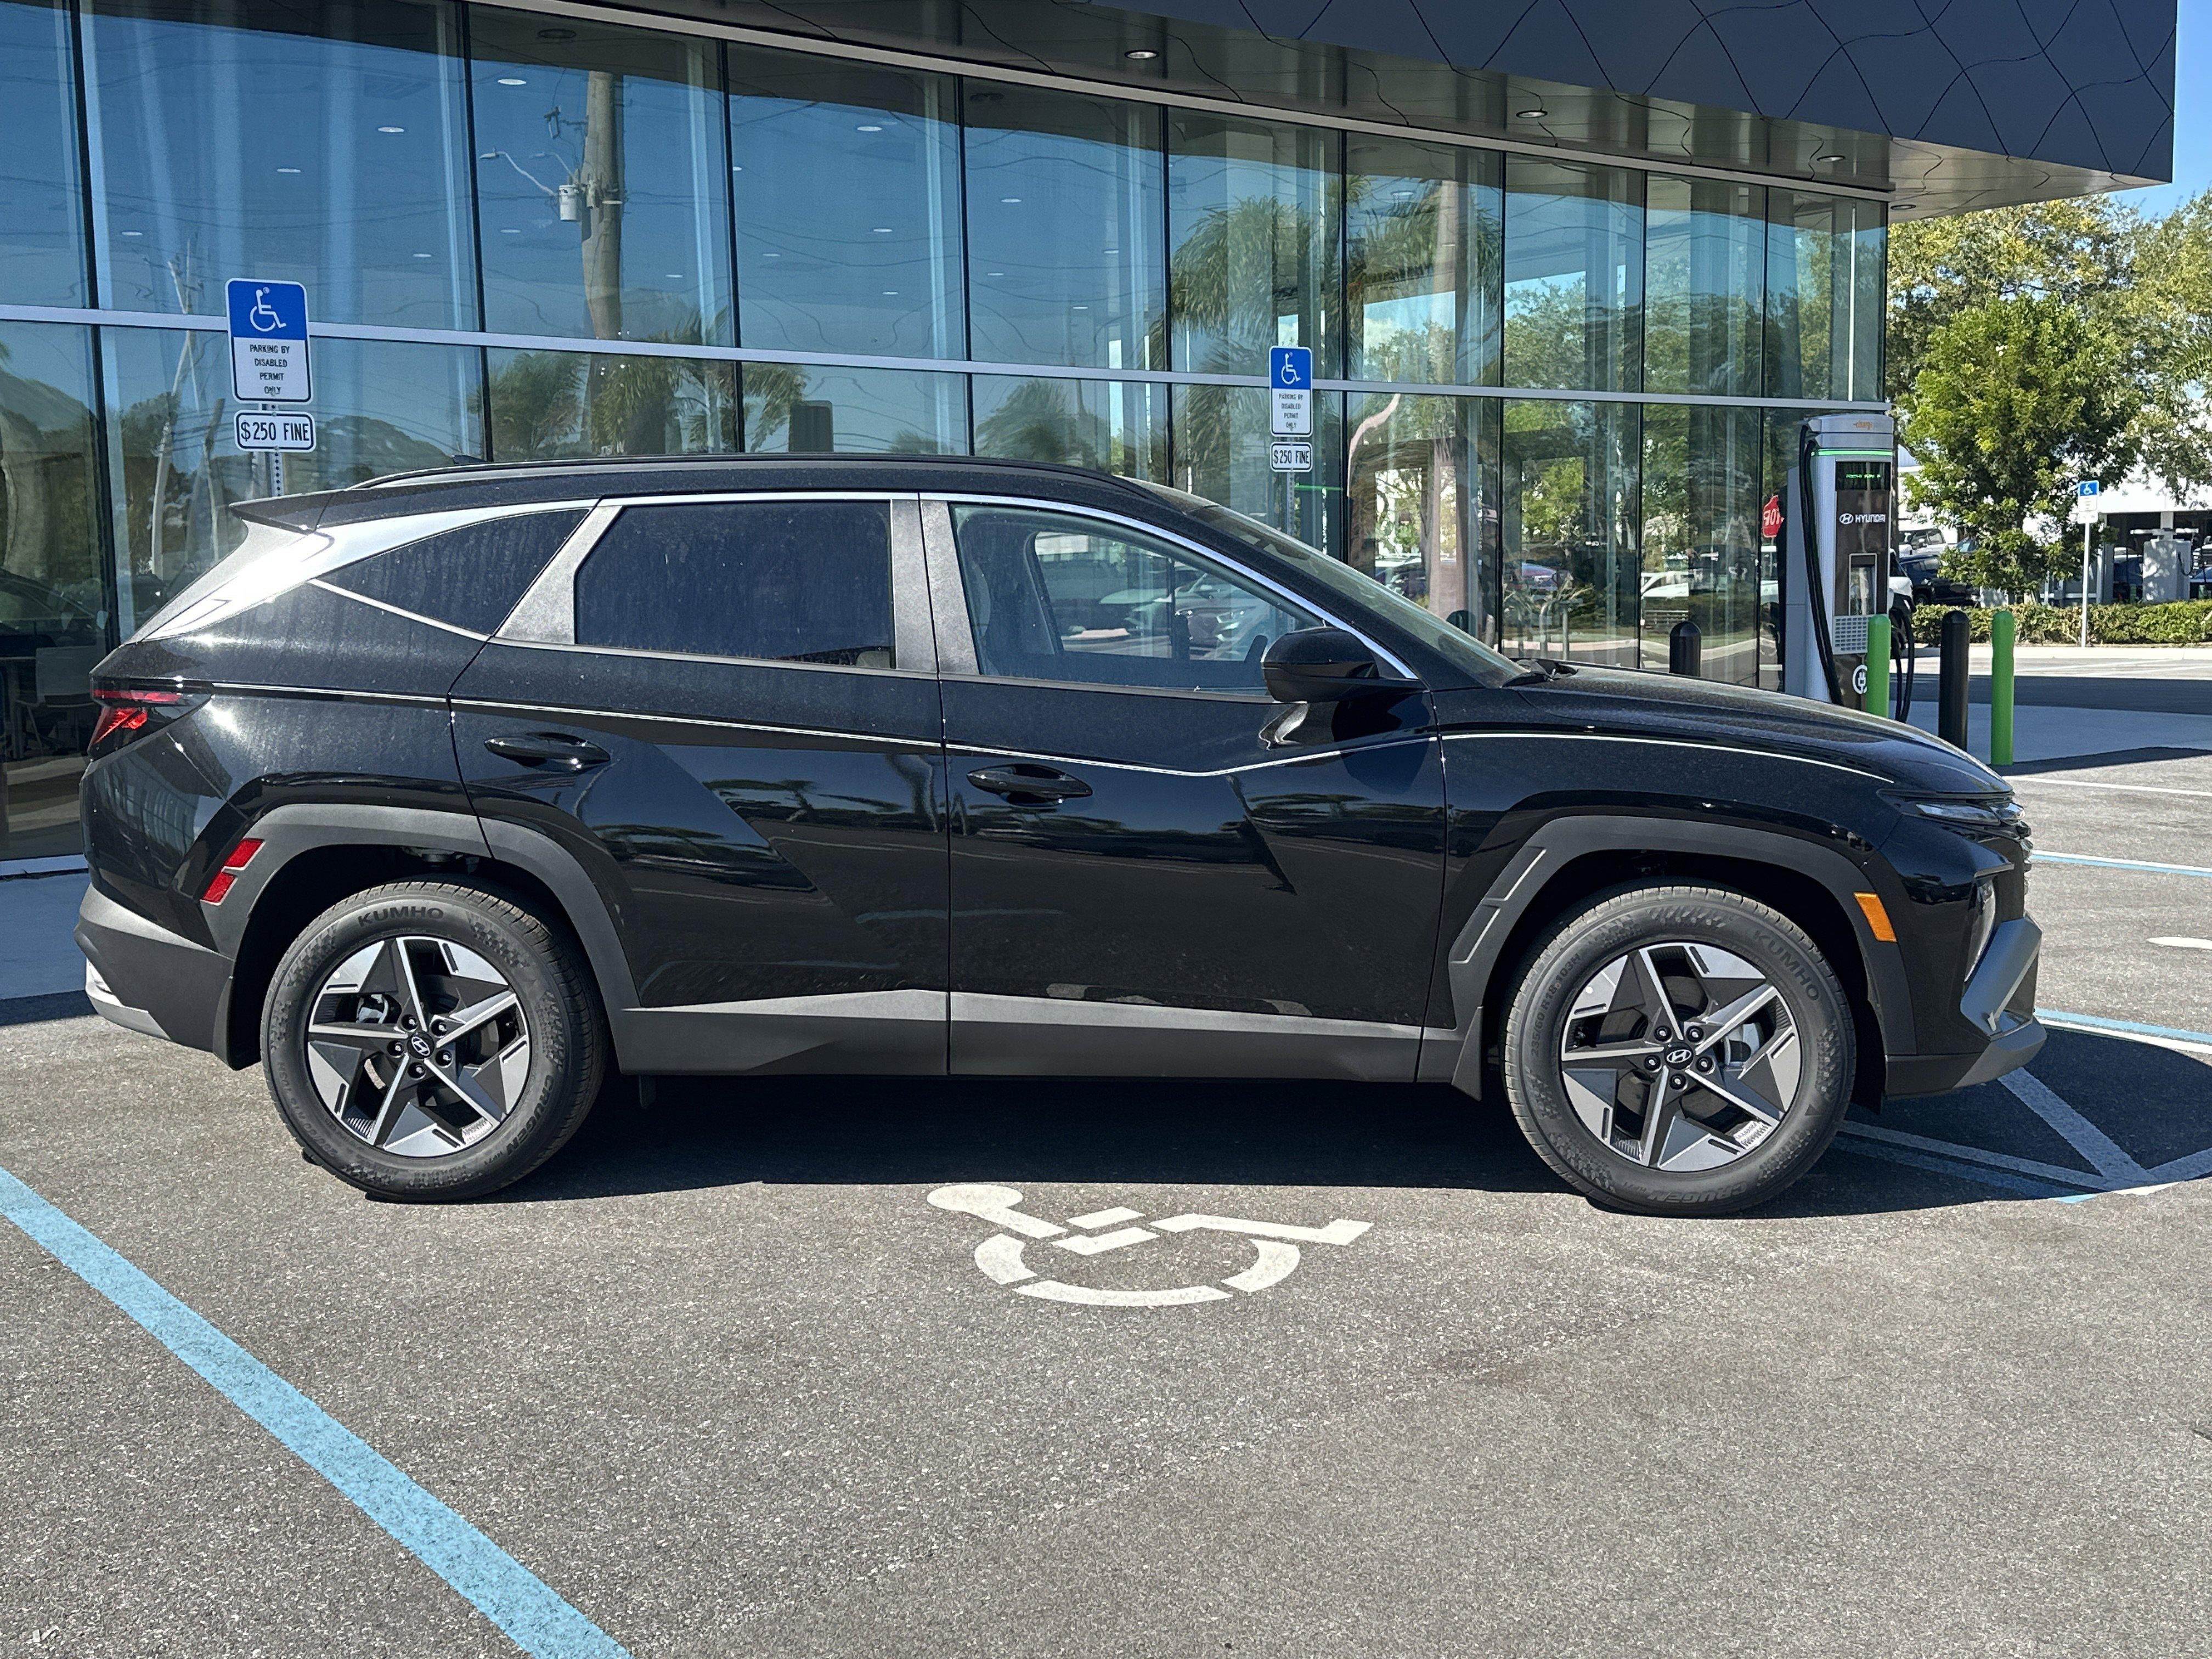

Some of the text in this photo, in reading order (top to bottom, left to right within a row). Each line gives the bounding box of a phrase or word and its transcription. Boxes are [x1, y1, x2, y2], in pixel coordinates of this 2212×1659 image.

[250, 344, 290, 354] PARKING BY
[254, 358, 287, 368] DISABLED
[259, 372, 284, 381] PERMIT
[264, 386, 281, 395] ONLY
[240, 420, 309, 442] $250 FINE
[1273, 450, 1310, 465] $250 FINE
[1855, 514, 1886, 523] HYUNDAI
[358, 906, 444, 927] KUMHO
[1755, 930, 1820, 1001] KUMHO
[1530, 953, 1581, 1058] 235/60 R18 103H
[506, 1075, 554, 1155] CRUGEN
[1647, 1181, 1747, 1203] CRUGEN
